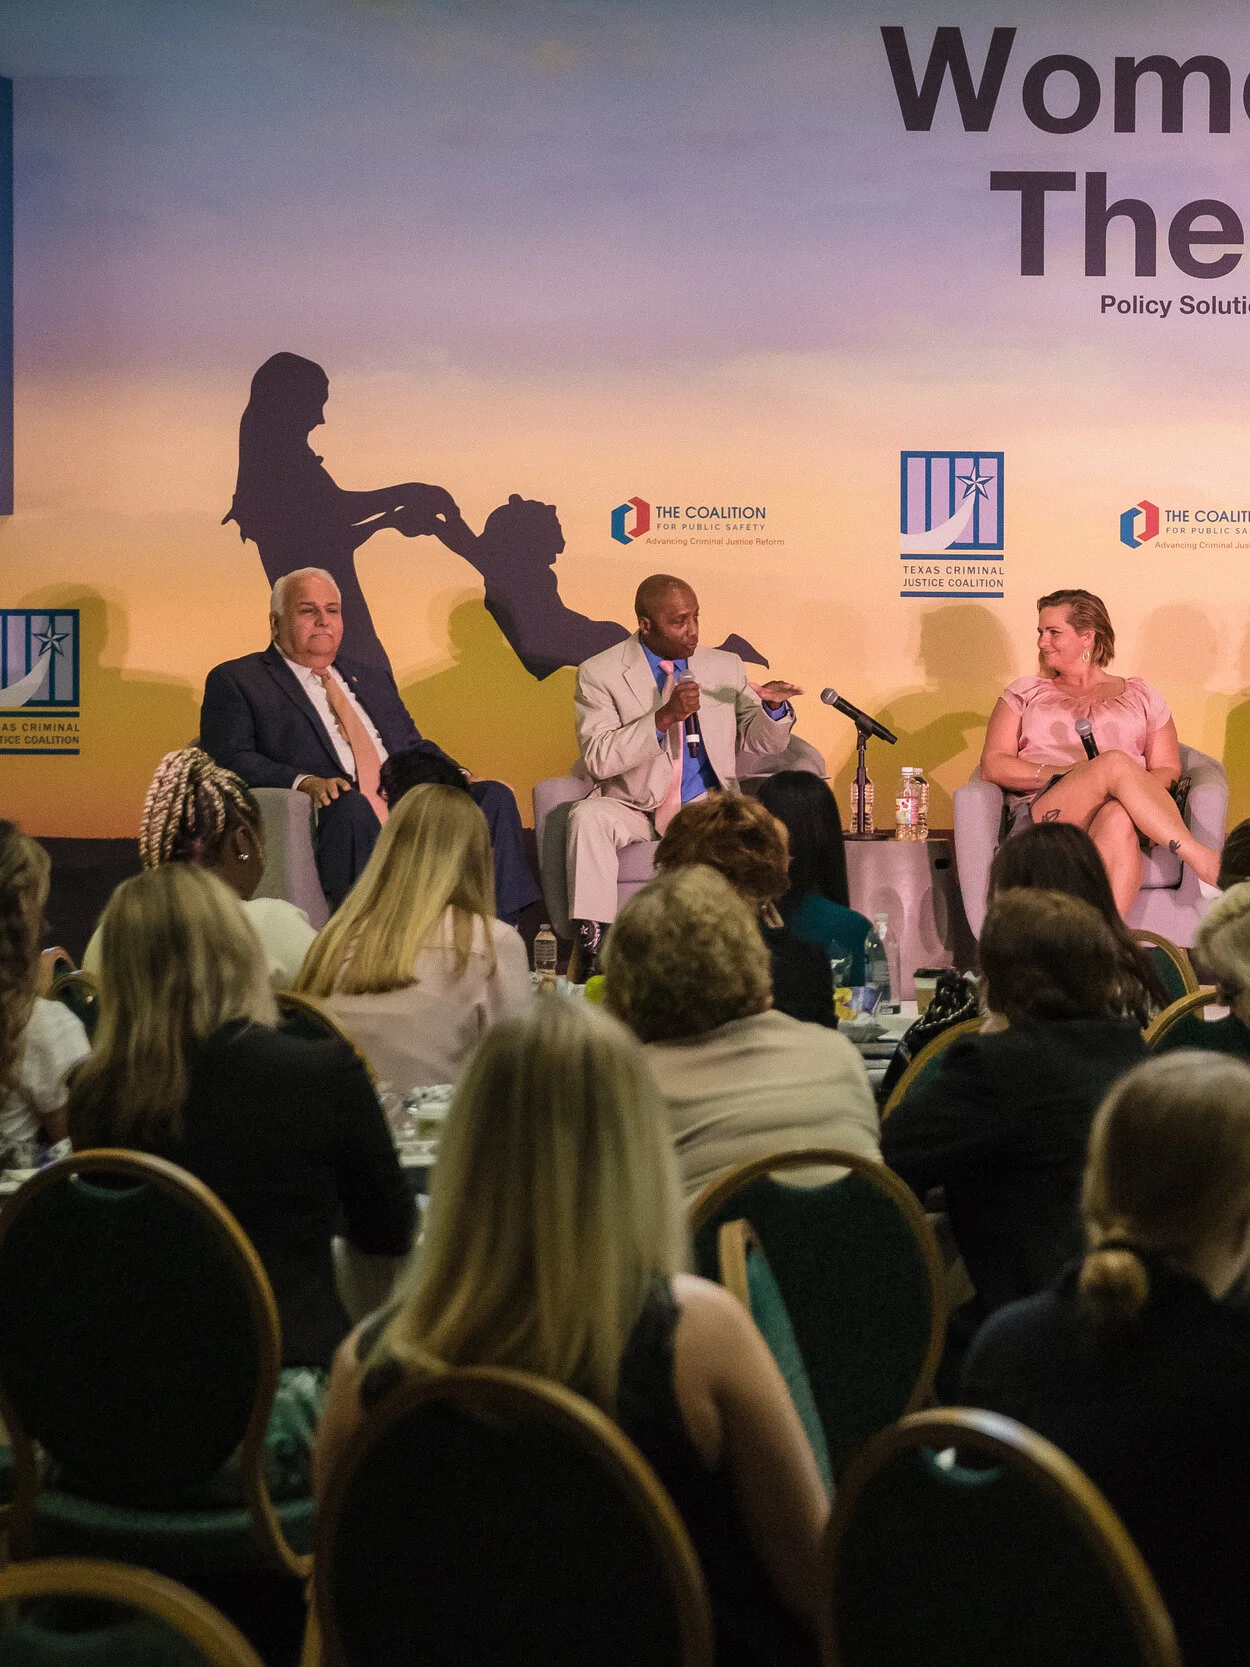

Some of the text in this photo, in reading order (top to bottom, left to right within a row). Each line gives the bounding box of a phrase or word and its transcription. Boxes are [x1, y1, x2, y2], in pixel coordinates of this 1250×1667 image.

[989, 170, 1247, 278] The
[1101, 295, 1172, 318] Policy
[656, 506, 766, 519] THE COALITION
[1165, 510, 1190, 523] THE
[656, 522, 765, 531] FOR PUBLIC SAFETY
[1165, 527, 1186, 535] FOR
[1191, 527, 1230, 535] PUBLIC
[645, 537, 785, 548] Advancing Criminal Justice Reform
[1154, 540, 1198, 551] Advancing
[1200, 540, 1232, 550] Criminal
[903, 566, 1004, 575] TEXAS CRIMINAL
[903, 578, 1004, 588] JUSTICE COALITION
[22, 722, 80, 732] CRIMINAL
[0, 735, 80, 745] TICE COALITION
